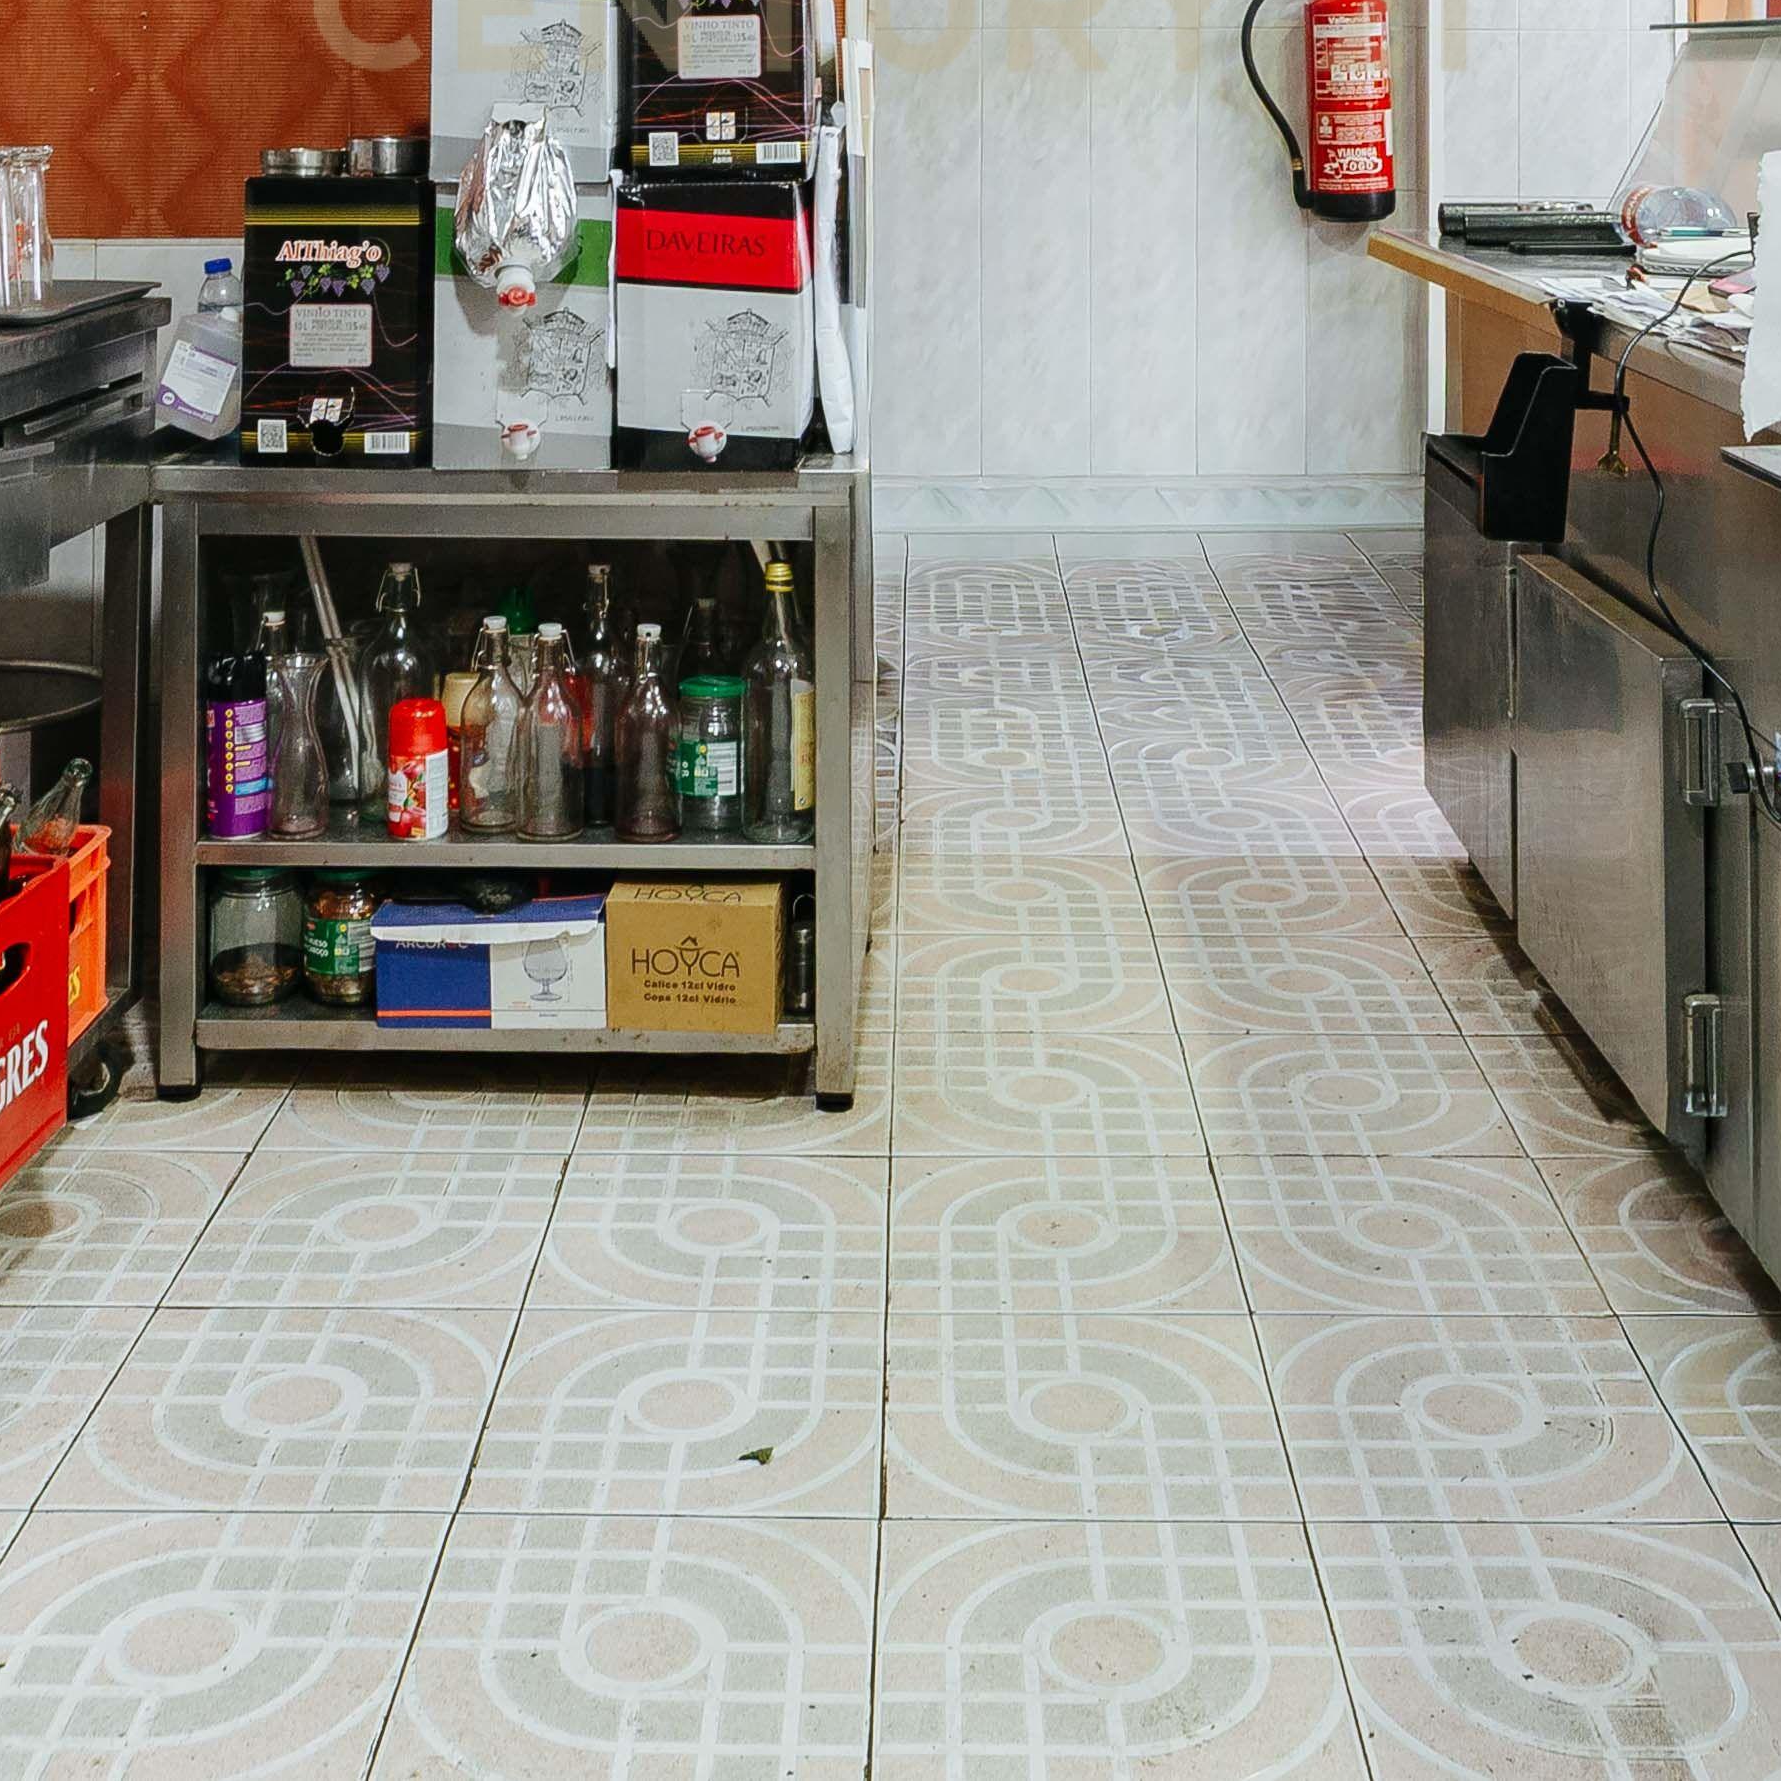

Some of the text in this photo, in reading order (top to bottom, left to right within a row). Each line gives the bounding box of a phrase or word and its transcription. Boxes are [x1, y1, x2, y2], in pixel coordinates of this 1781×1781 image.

[683, 20, 755, 31] VINHO TINTO
[296, 308, 367, 318] VINHO TINTO
[634, 886, 742, 903] HOYCA
[631, 945, 741, 979] HOYCA
[681, 980, 704, 990] 12cl
[706, 981, 737, 992] Vidro
[643, 992, 737, 1006] Copa 12cl Vidrio
